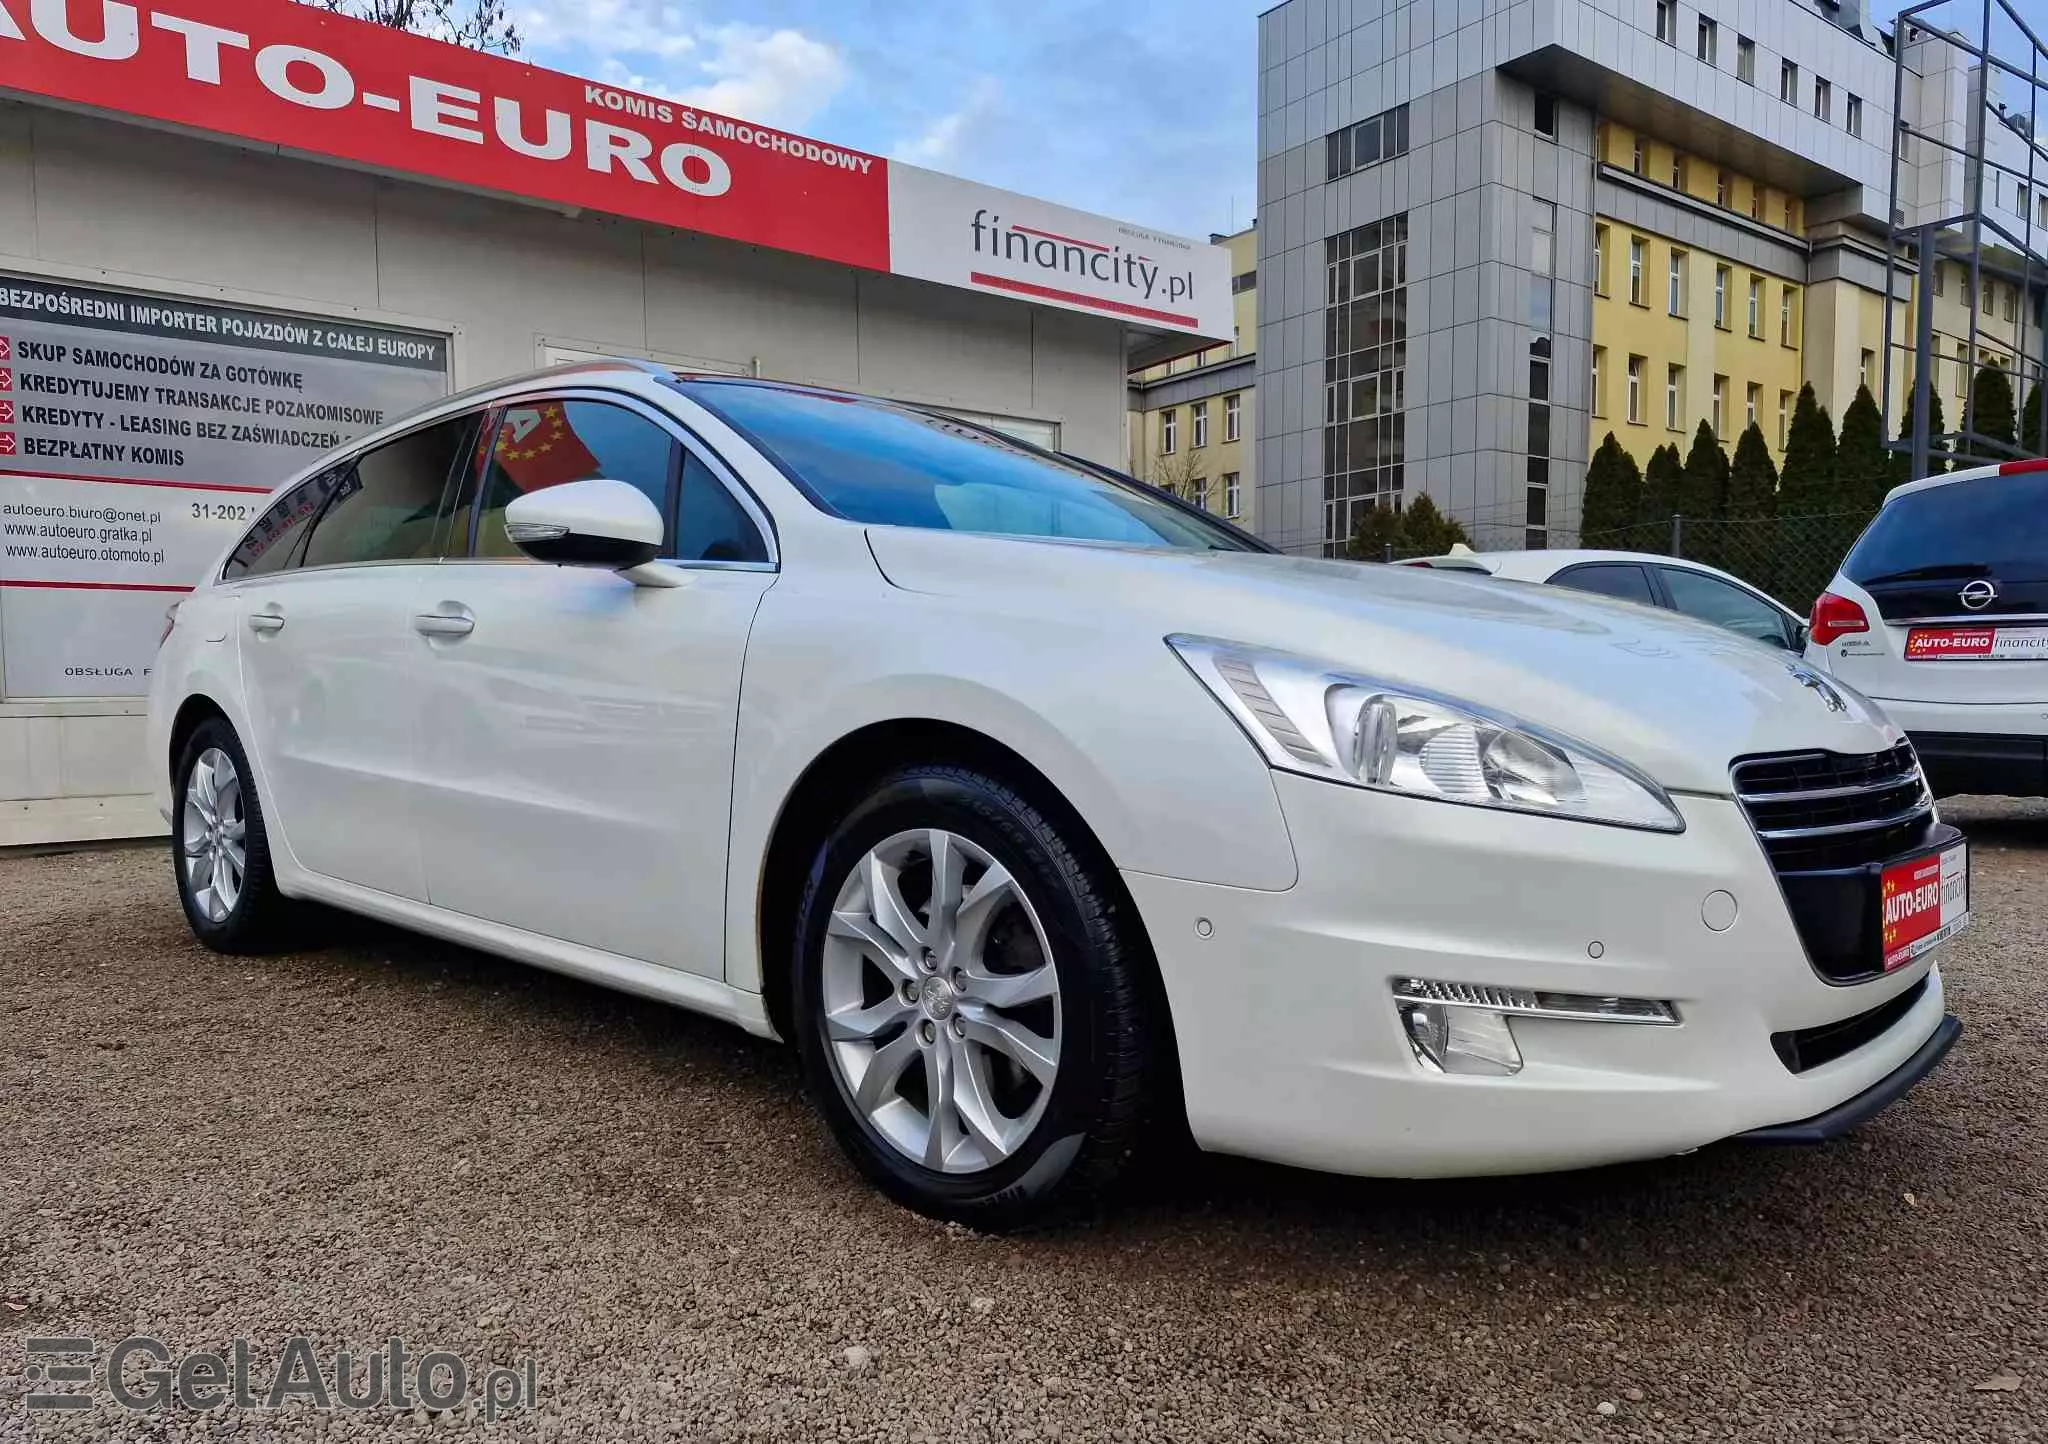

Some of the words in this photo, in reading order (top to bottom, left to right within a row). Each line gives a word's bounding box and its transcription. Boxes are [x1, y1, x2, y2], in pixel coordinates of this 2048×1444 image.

[585, 85, 673, 123] KOMIS
[682, 110, 872, 175] SAMOCHODOWY
[971, 209, 1193, 303] financity.pl
[0, 287, 125, 321] BEZPOŚREDNI
[131, 305, 217, 334] IMPORTER
[222, 316, 308, 345] POJAZDÓW
[312, 330, 323, 347] Z
[327, 332, 373, 353] CAŁEJ
[378, 338, 435, 361] EUROPY
[18, 341, 67, 363] SKUP
[72, 347, 195, 377] SAMOCHODÓW
[200, 362, 221, 380] ZA
[225, 365, 303, 393] GOTÓWKĘ
[20, 373, 149, 402] KREDYTUJEMY
[155, 387, 261, 414] TRANSAKCJE
[265, 399, 384, 425] POZAKOMISOWE
[22, 404, 104, 429] KREDYTY
[120, 414, 191, 437] LEASING
[197, 422, 227, 440] BEZ
[232, 424, 339, 448] ZAŚWIADCZEŃ
[24, 437, 130, 462] BEZPŁATNY
[131, 446, 184, 466] KOMIS
[3, 503, 161, 525] autoeuro.biuro@onet.pl
[191, 502, 246, 521] 31-202
[4, 522, 152, 543] www.autoeuro.gratka.pl
[6, 543, 164, 566] www.autoeuro.otomoto.pl
[1915, 637, 1989, 648] AUTO-EURO
[64, 667, 133, 677] OBSŁUGA
[1886, 882, 1939, 925] AUTO-EURO
